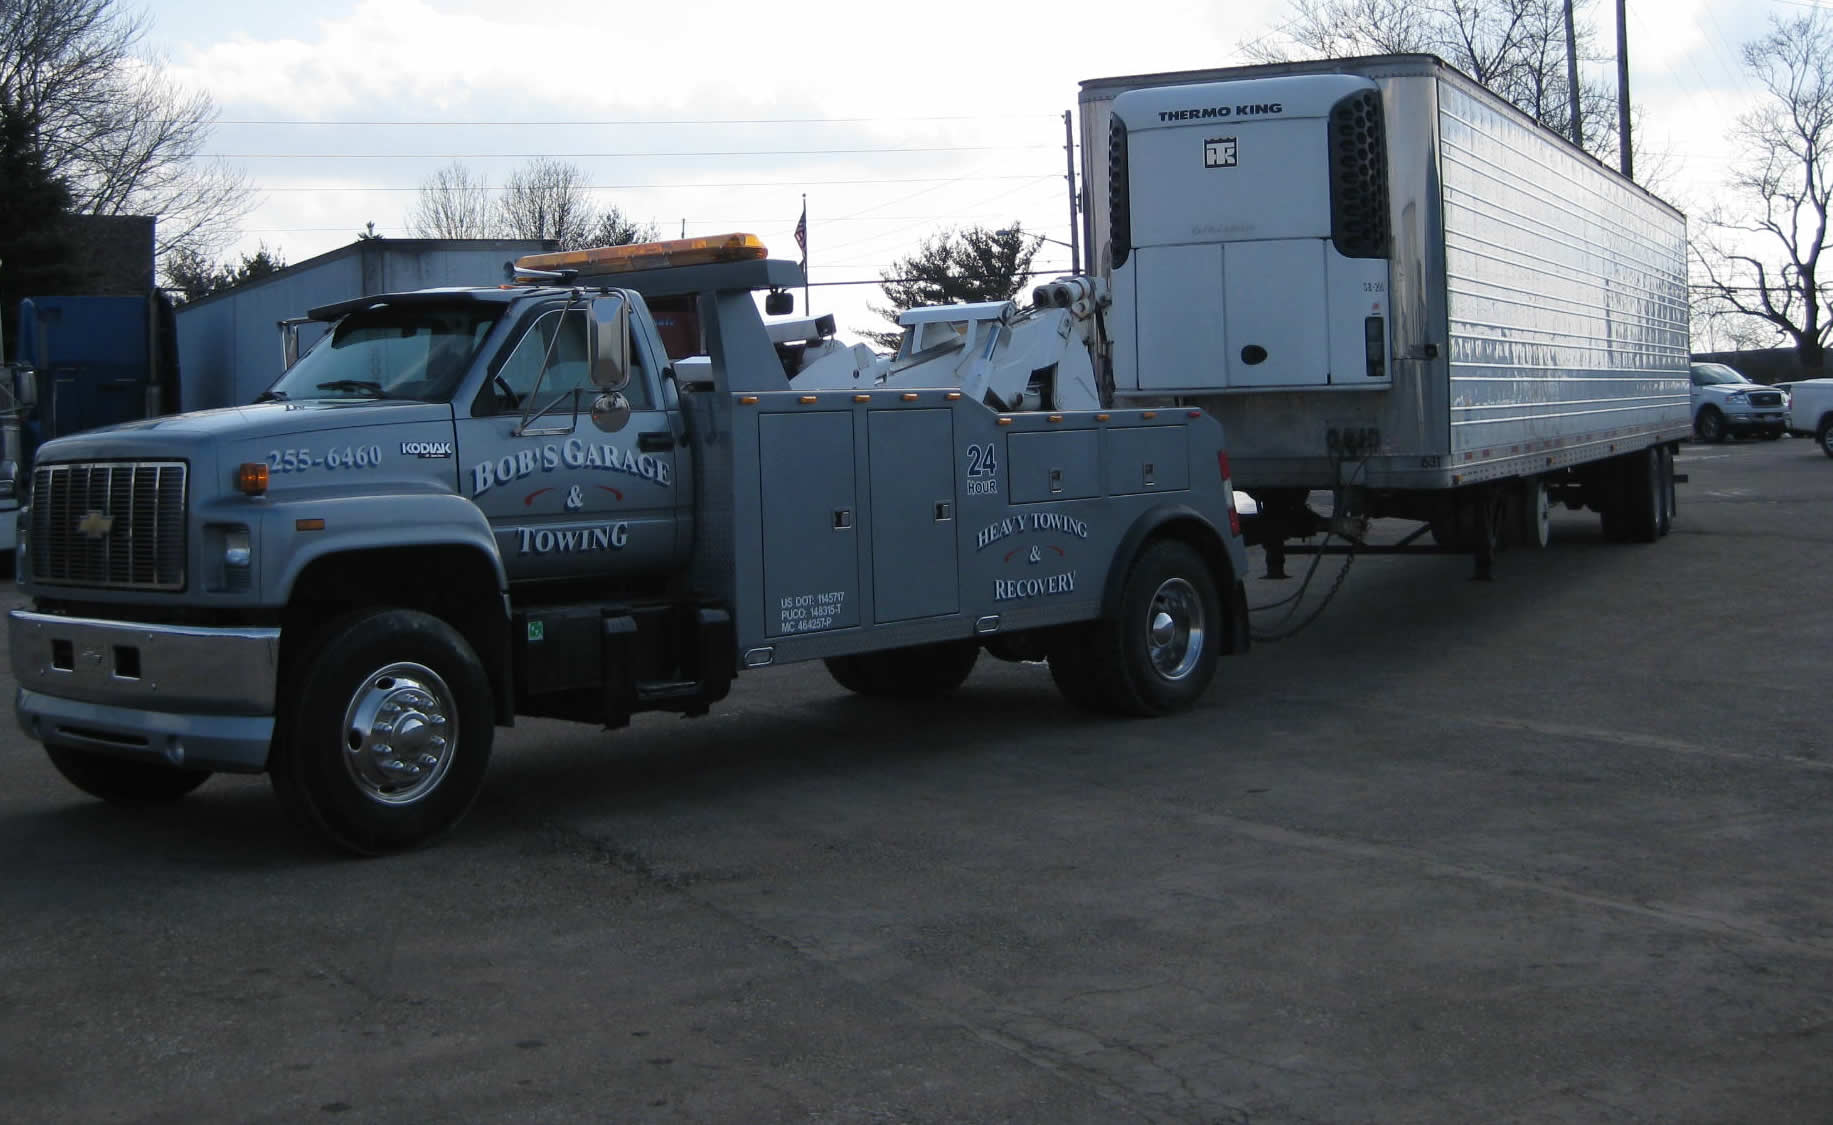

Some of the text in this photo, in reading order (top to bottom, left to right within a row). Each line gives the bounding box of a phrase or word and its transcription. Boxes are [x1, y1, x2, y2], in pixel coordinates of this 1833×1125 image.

[1158, 103, 1283, 121] THERMO KING
[268, 445, 383, 473] 255-6460
[402, 442, 452, 455] KODIAK
[967, 443, 997, 477] 24
[474, 438, 672, 497] BOB'S GARAGE
[566, 484, 585, 509] &
[967, 479, 998, 495] HOUR
[517, 521, 629, 554] TOWING
[976, 512, 1089, 549] HEAVY TOWING
[1028, 545, 1041, 563] &
[994, 570, 1077, 600] RECOVERY
[781, 597, 793, 608] US
[781, 621, 796, 633] MC
